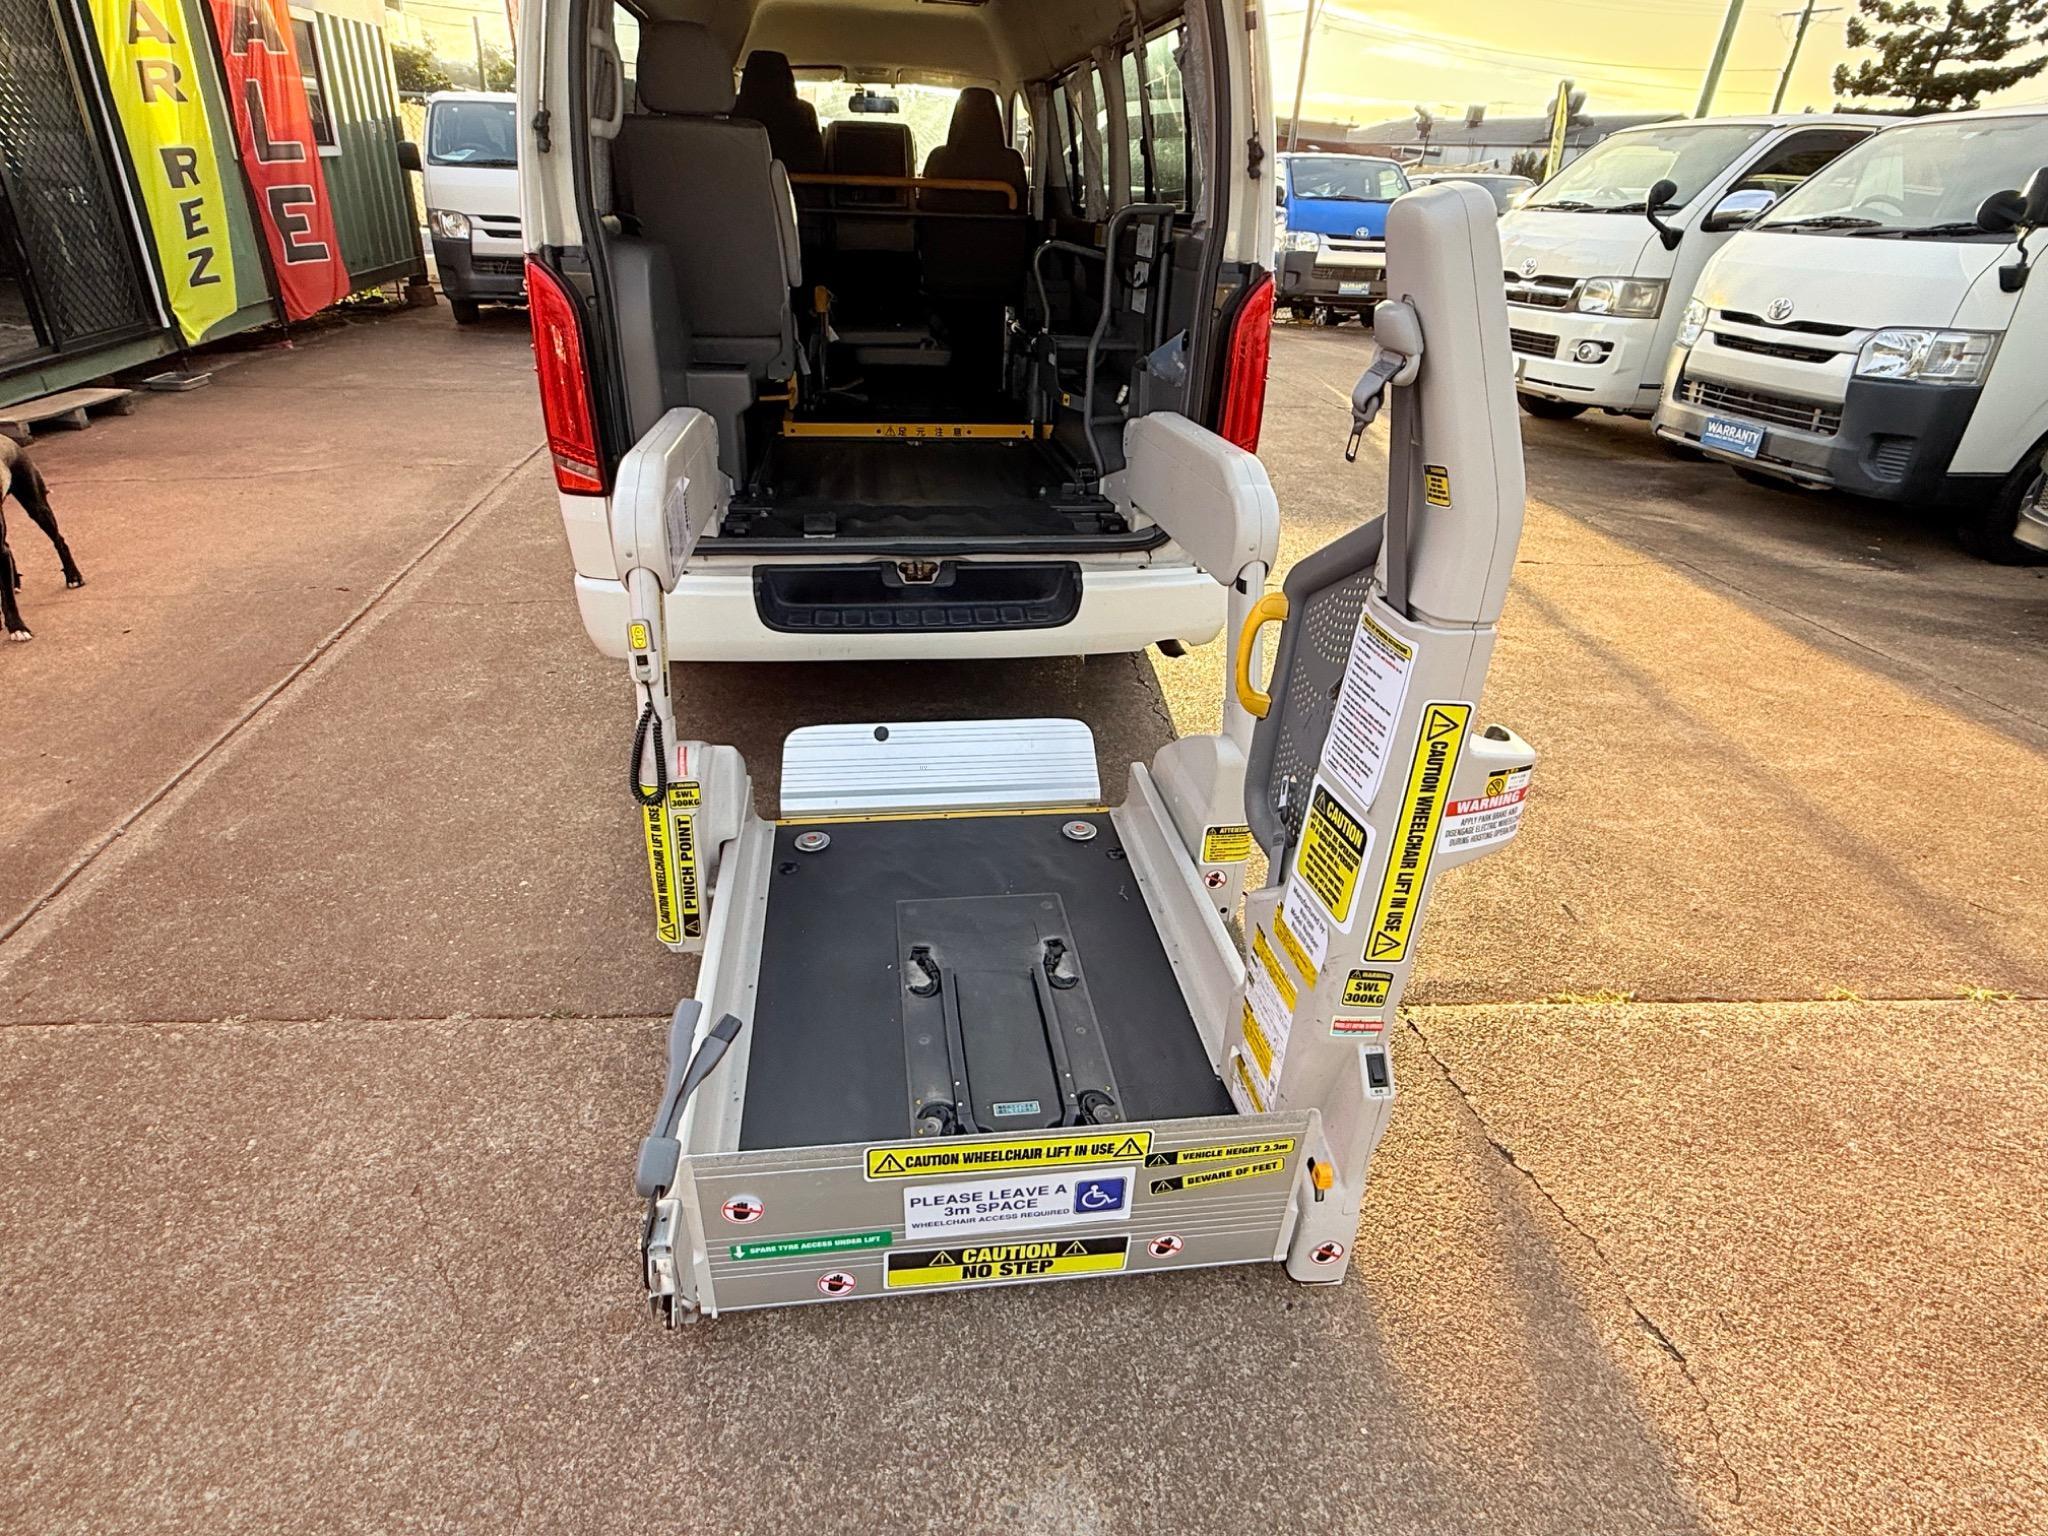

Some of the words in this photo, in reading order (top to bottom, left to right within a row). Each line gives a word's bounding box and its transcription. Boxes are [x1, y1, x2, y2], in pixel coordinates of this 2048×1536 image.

[158, 147, 221, 288] REZ
[1708, 421, 1758, 444] WARRANTY
[1420, 741, 1448, 792] CAUTION
[648, 807, 659, 821] USE
[1457, 791, 1520, 814] WARNING
[1327, 801, 1363, 849] CAUTION
[1400, 796, 1434, 869] WHEELCHAIR
[652, 834, 663, 849] LIFT
[677, 819, 692, 861] POINT
[654, 850, 668, 893] WHEELCHAIR
[682, 867, 696, 909] PINCH
[1394, 873, 1414, 894] LIFT
[659, 896, 670, 923] CAUTION
[1293, 886, 1320, 925] Manufactured
[1390, 898, 1408, 908] IN
[1384, 909, 1405, 932] USE
[1345, 993, 1384, 1003] 300KG
[1355, 982, 1380, 992] SWL
[905, 1153, 958, 1167] CAUTION
[963, 1147, 1041, 1163] WHEELCHAIR
[1046, 1145, 1071, 1158] LIFT
[1074, 1144, 1086, 1156] IN
[1091, 1142, 1113, 1155] USE
[1182, 1149, 1221, 1159] VEHICLE
[1225, 1146, 1260, 1155] HEIGHT
[1187, 1170, 1232, 1184] BEWARE
[1235, 1166, 1248, 1175] OF
[1252, 1161, 1277, 1172] FEET
[910, 1191, 983, 1208] PLEASE
[989, 1185, 1049, 1201] LEAVE
[1055, 1184, 1067, 1194] A
[912, 1217, 976, 1229] WHEELCHAIR
[978, 1213, 1019, 1223] ACCESS
[1021, 1208, 1070, 1218] REQUIRED
[944, 1206, 970, 1217] 3m
[976, 1199, 1038, 1214] SPACE
[749, 1245, 776, 1254] SPARE
[778, 1243, 798, 1251] TYRE
[801, 1240, 832, 1248] ACCESS
[834, 1237, 861, 1245] UNDER
[962, 1243, 1057, 1264] CAUTION
[961, 1263, 992, 1279] NO
[999, 1259, 1054, 1276] STEP
